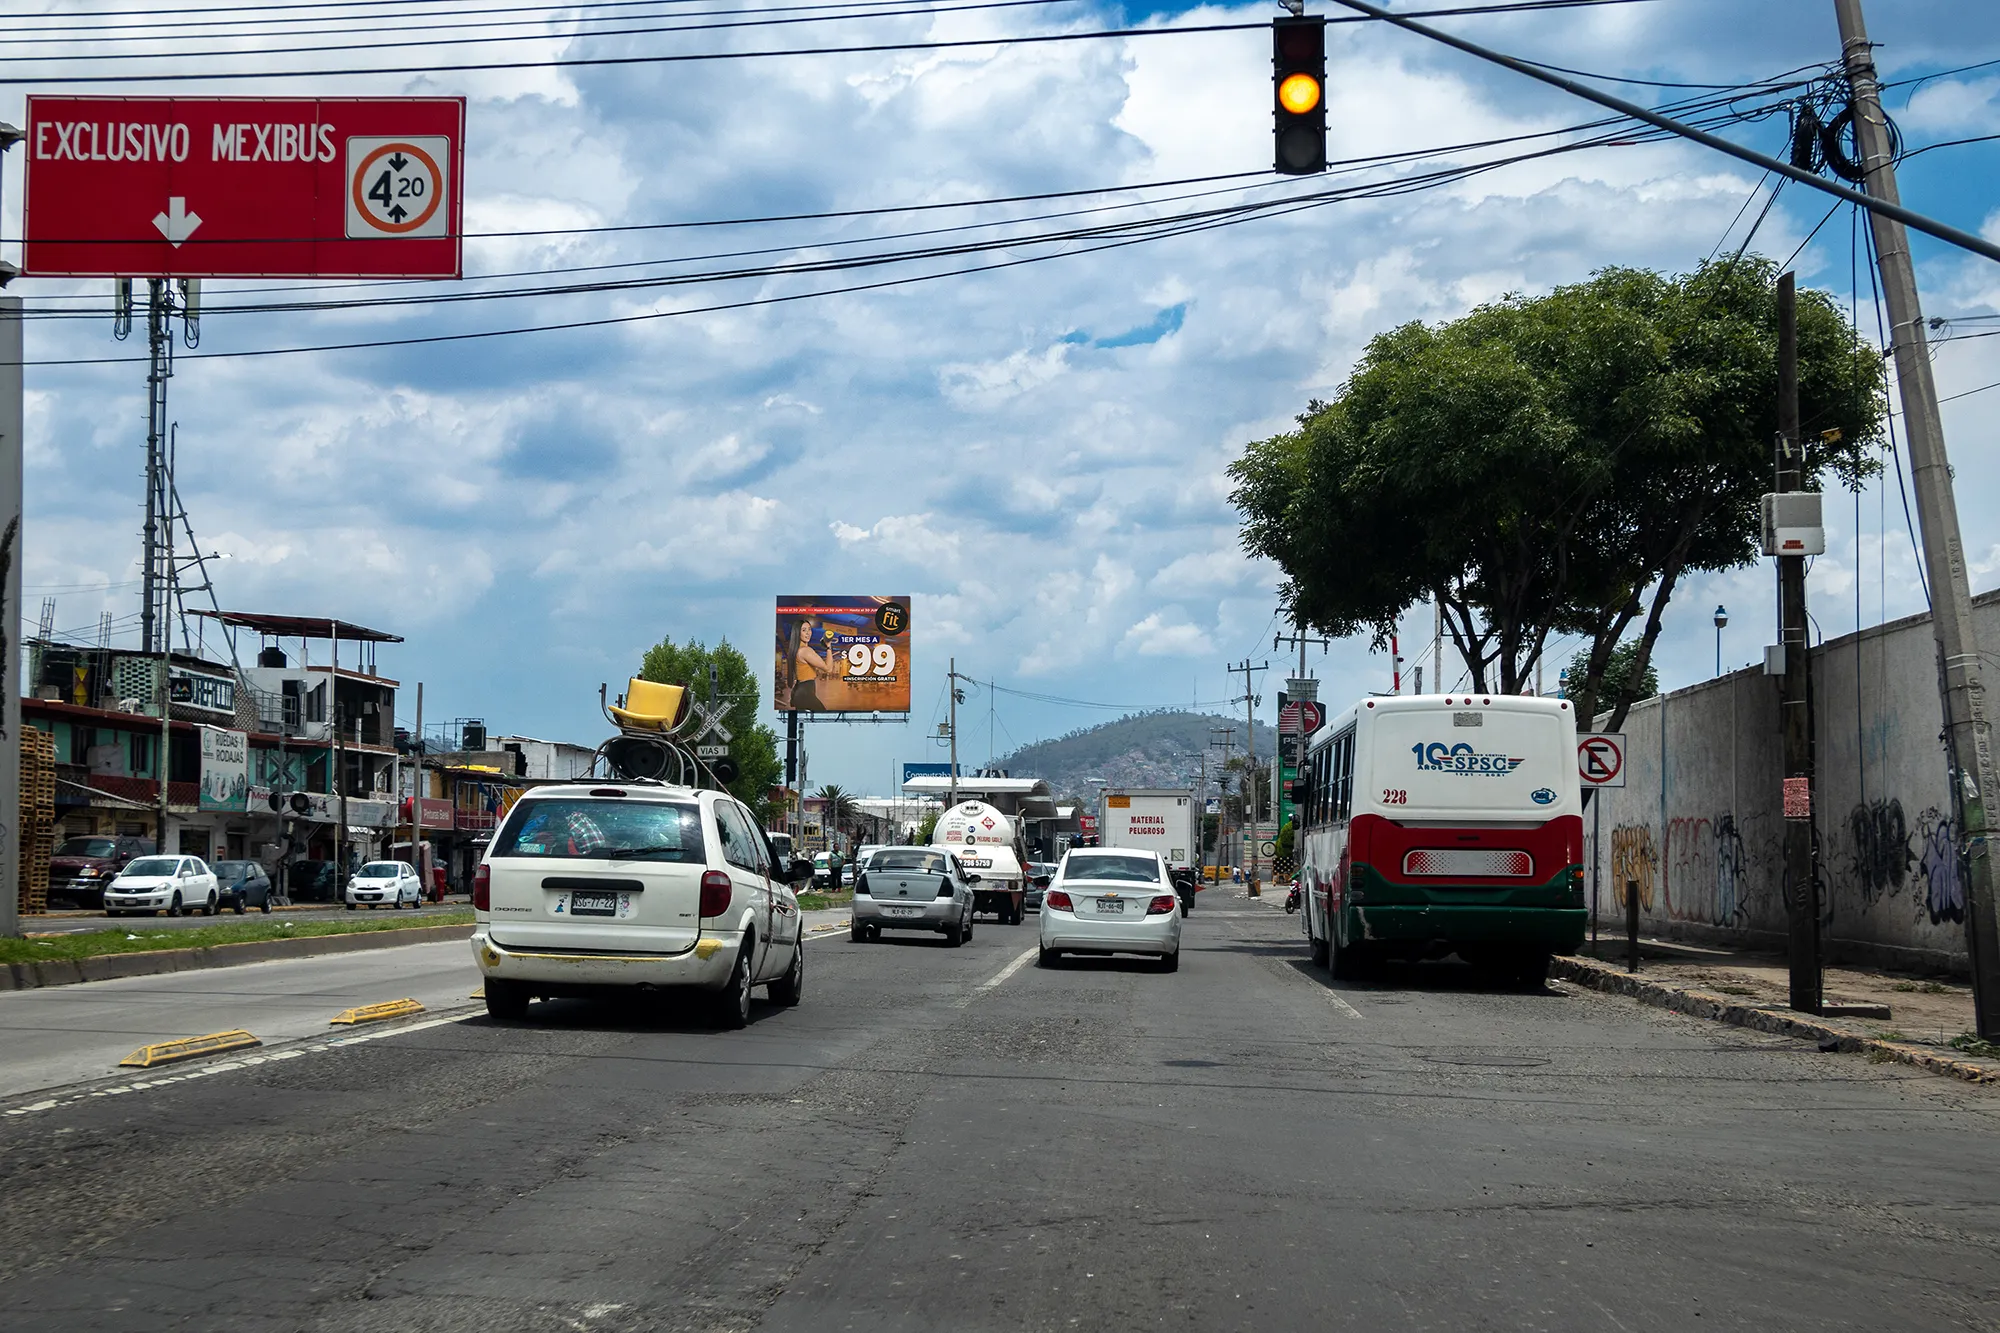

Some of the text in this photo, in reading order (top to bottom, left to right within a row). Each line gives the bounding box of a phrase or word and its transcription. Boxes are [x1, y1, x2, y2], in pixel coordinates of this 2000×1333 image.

[36, 121, 337, 163] EXCLUSIVO MEXIBUS
[368, 170, 425, 208] 4 20
[882, 612, 900, 626] fit
[700, 746, 719, 755] VIAS
[1382, 788, 1407, 804] 228
